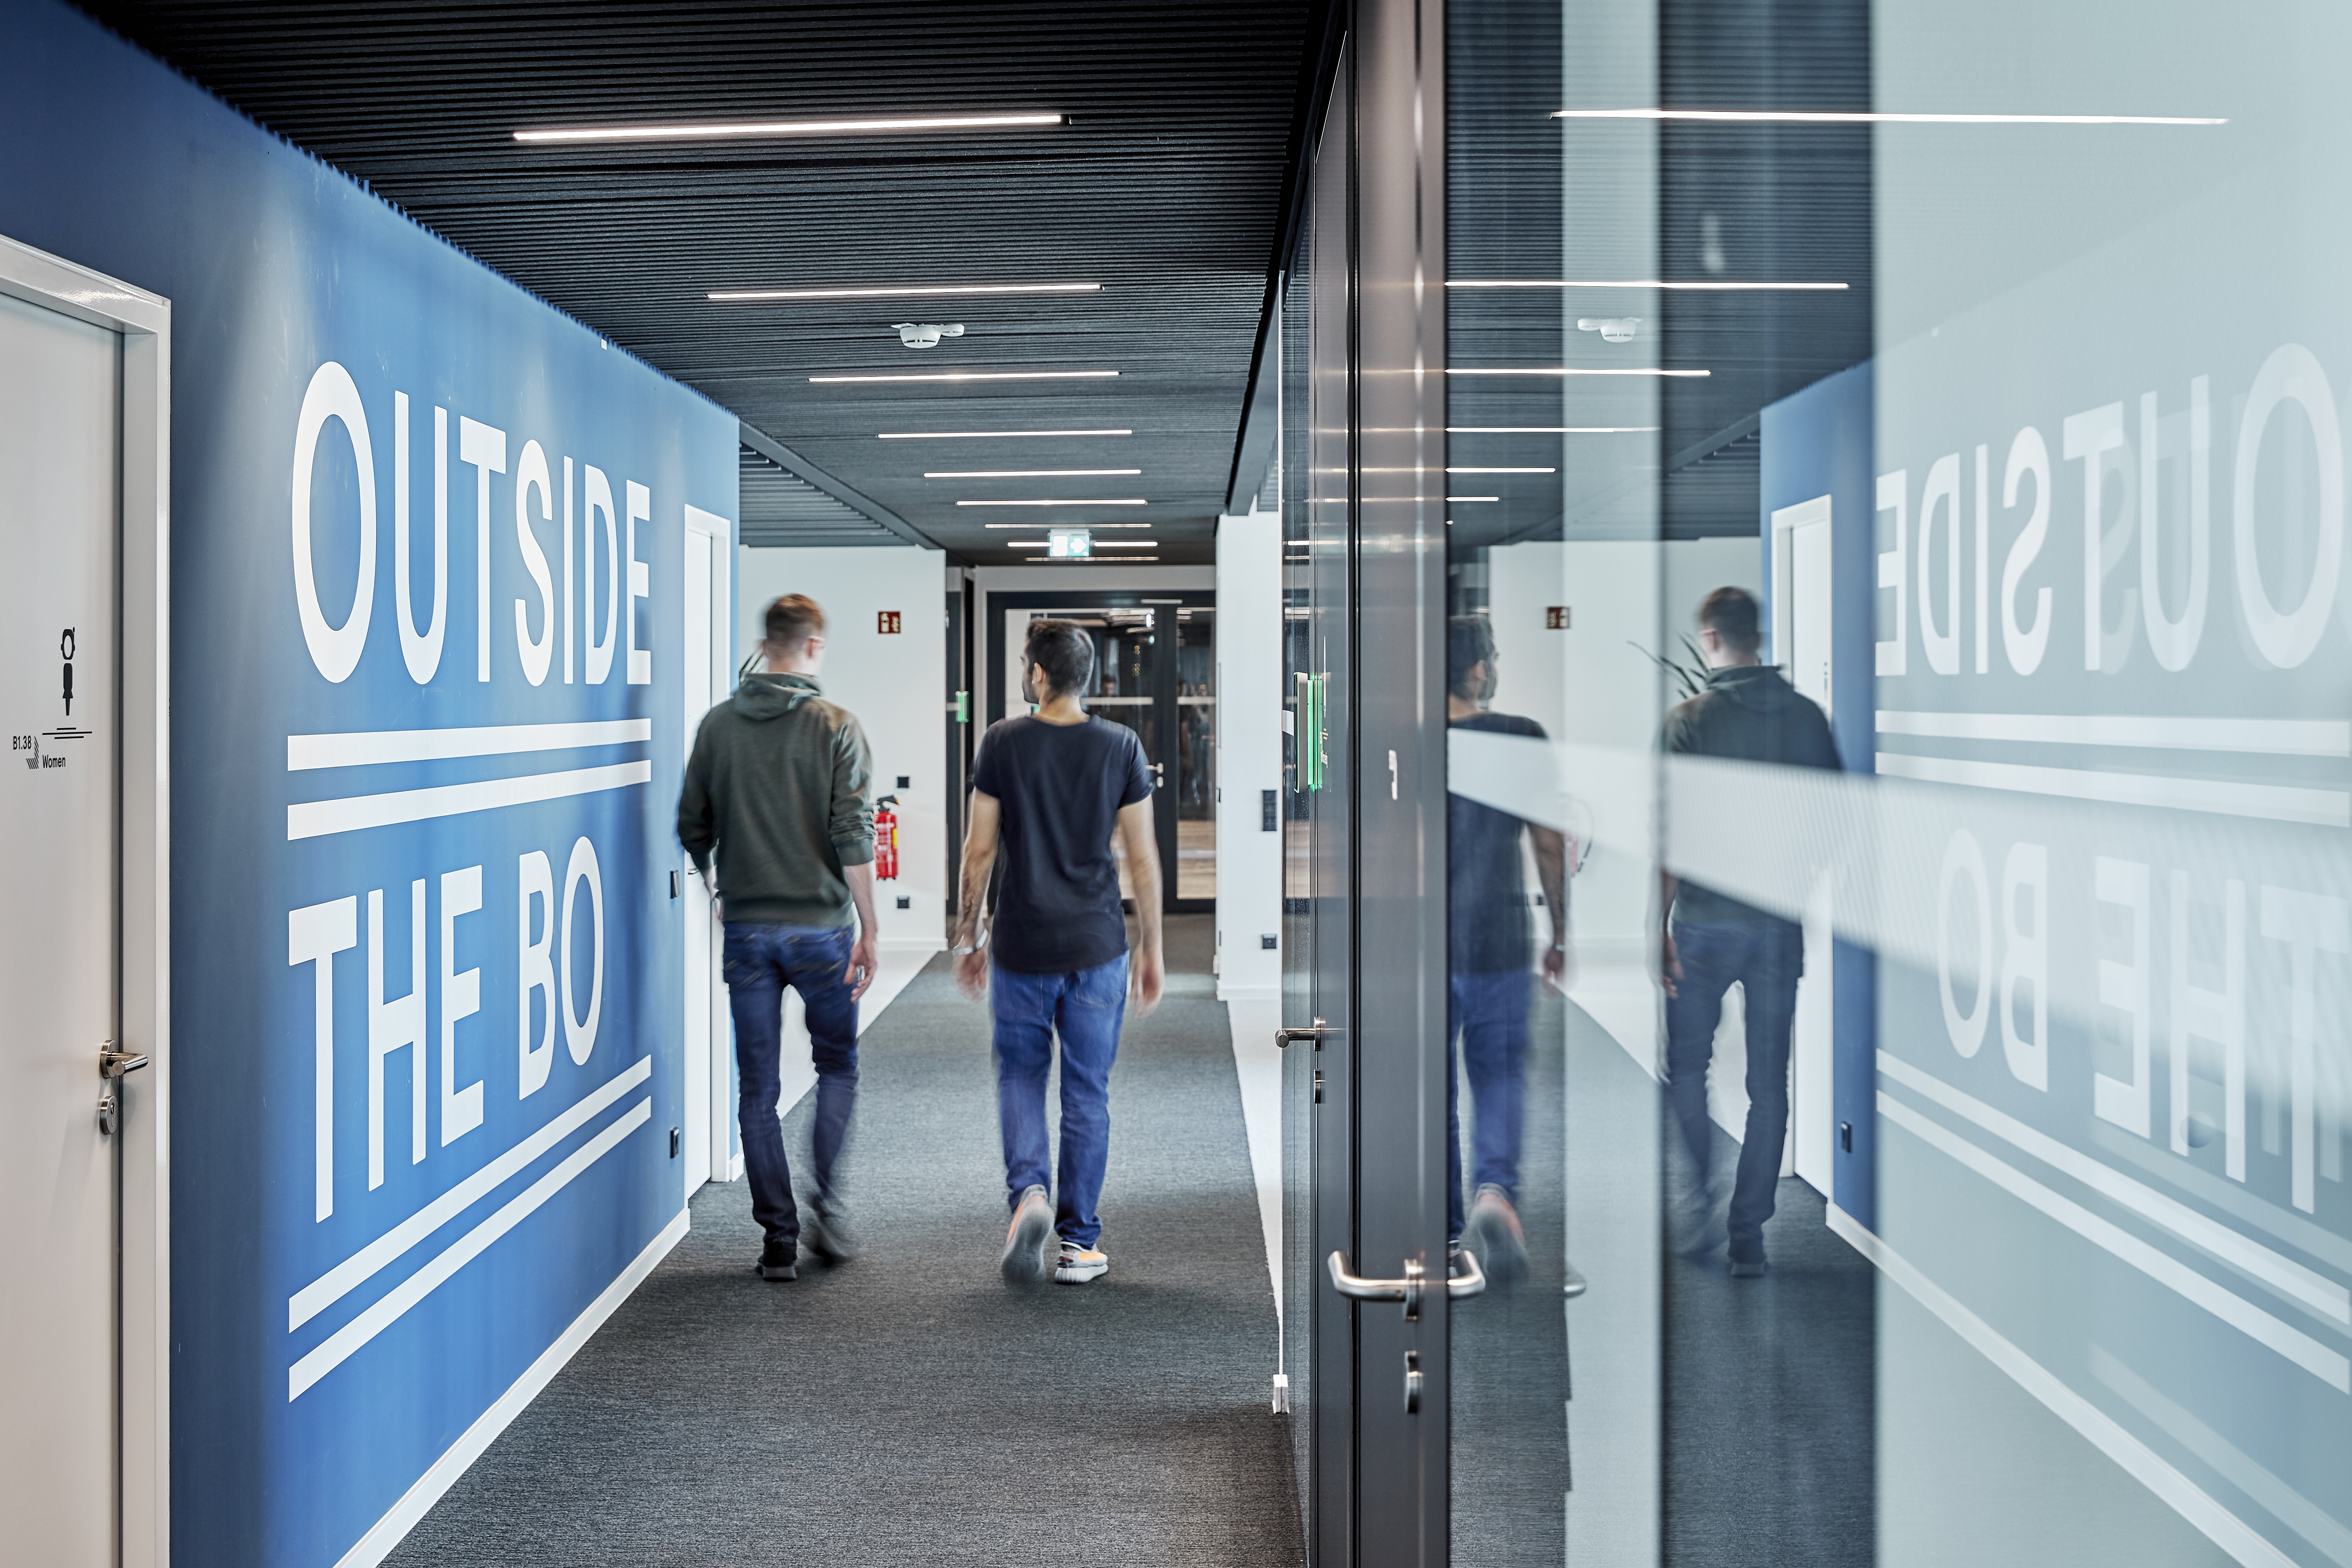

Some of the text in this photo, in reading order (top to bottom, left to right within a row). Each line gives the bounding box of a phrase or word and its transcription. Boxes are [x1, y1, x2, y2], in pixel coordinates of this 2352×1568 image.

[292, 360, 652, 686] OUTSIDE
[13, 735, 32, 750] B1.38
[42, 754, 66, 768] Women
[288, 836, 604, 1224] THE BO
